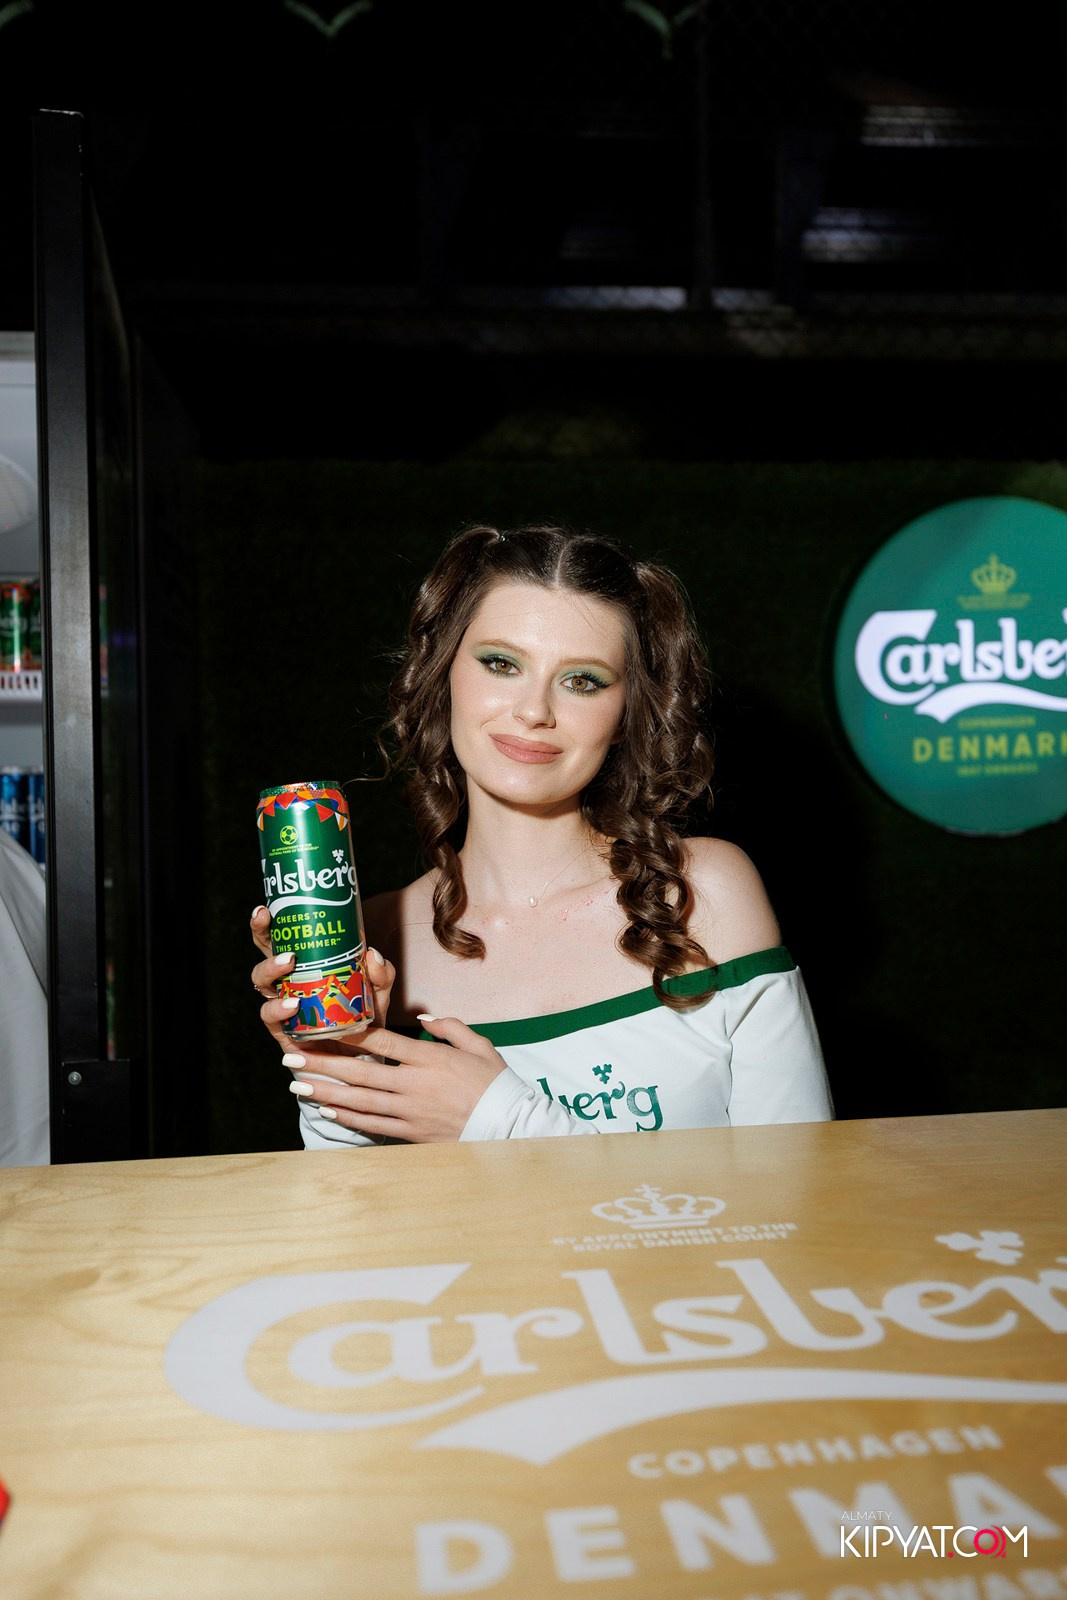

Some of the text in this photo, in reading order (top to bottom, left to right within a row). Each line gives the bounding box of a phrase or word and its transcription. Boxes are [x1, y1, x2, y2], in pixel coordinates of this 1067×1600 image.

[855, 609, 1067, 706] Carlsbe
[276, 910, 326, 925] CHEERS TO
[275, 943, 292, 953] THIS
[626, 1425, 1002, 1480] COPENHAGEN
